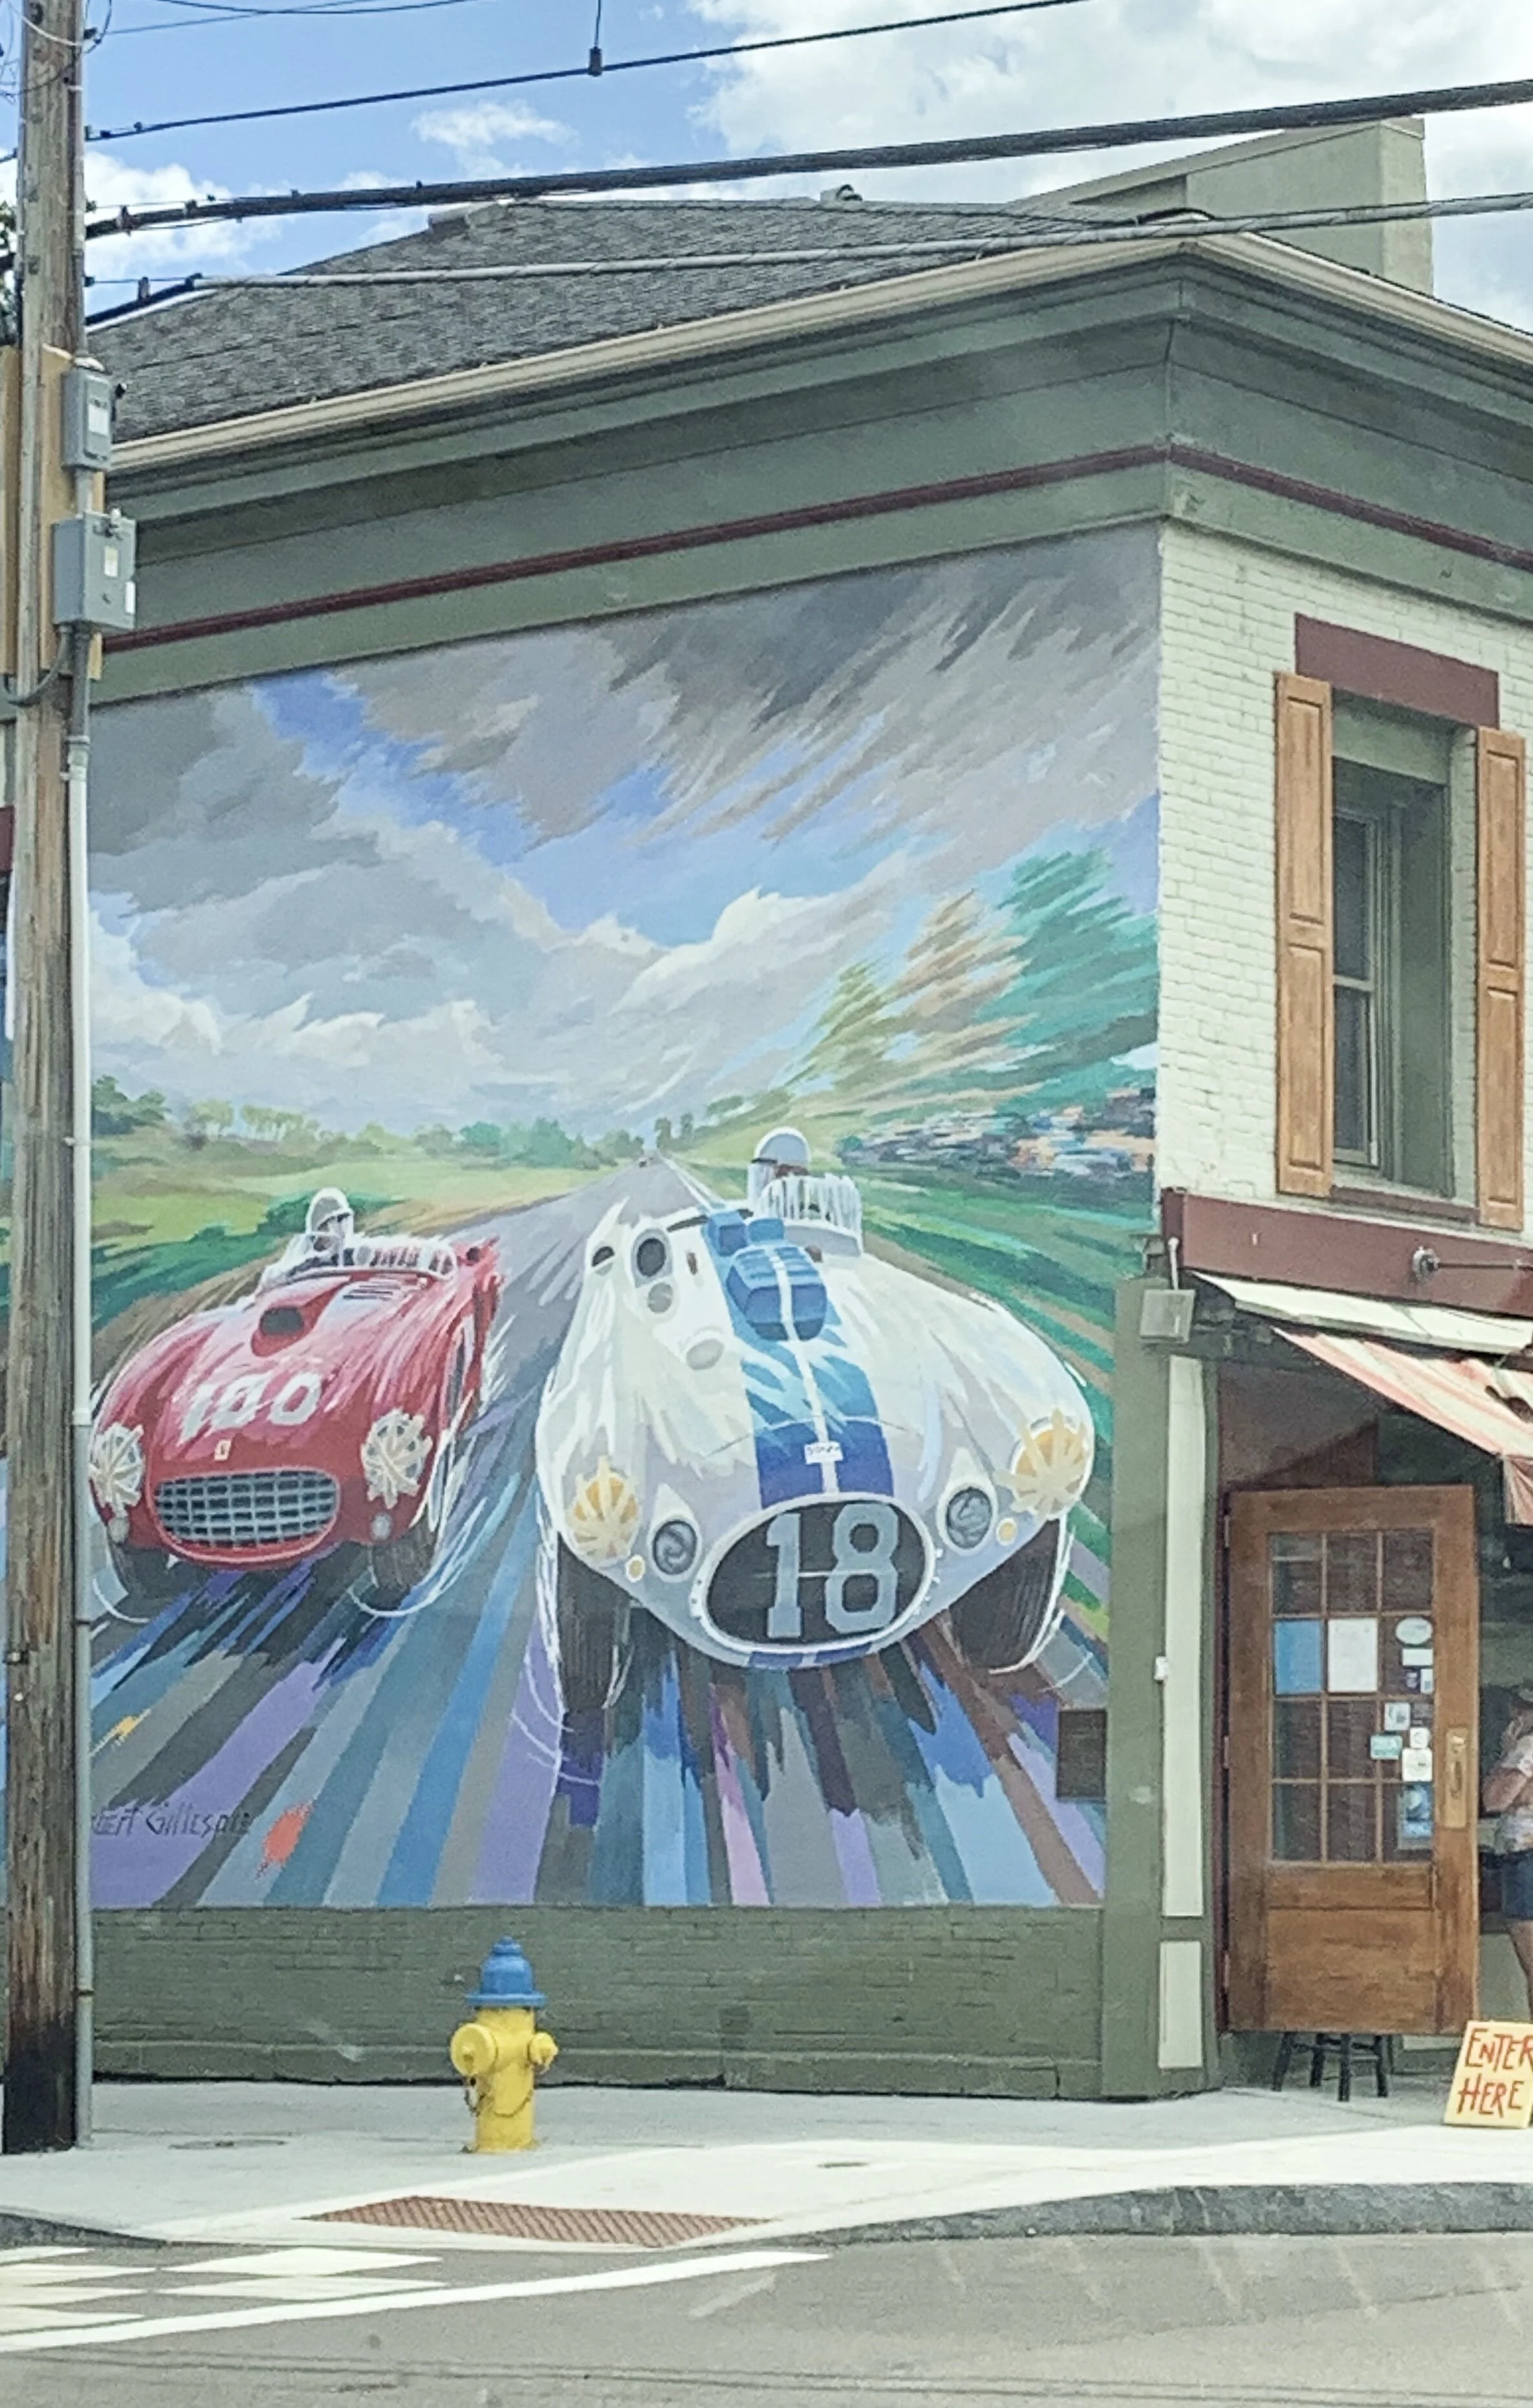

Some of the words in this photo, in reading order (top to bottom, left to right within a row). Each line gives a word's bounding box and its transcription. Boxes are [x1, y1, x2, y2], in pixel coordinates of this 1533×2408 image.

[766, 1502, 898, 1638] 18
[1464, 2028, 1533, 2073] ENTER
[1457, 2073, 1524, 2118] HERE
